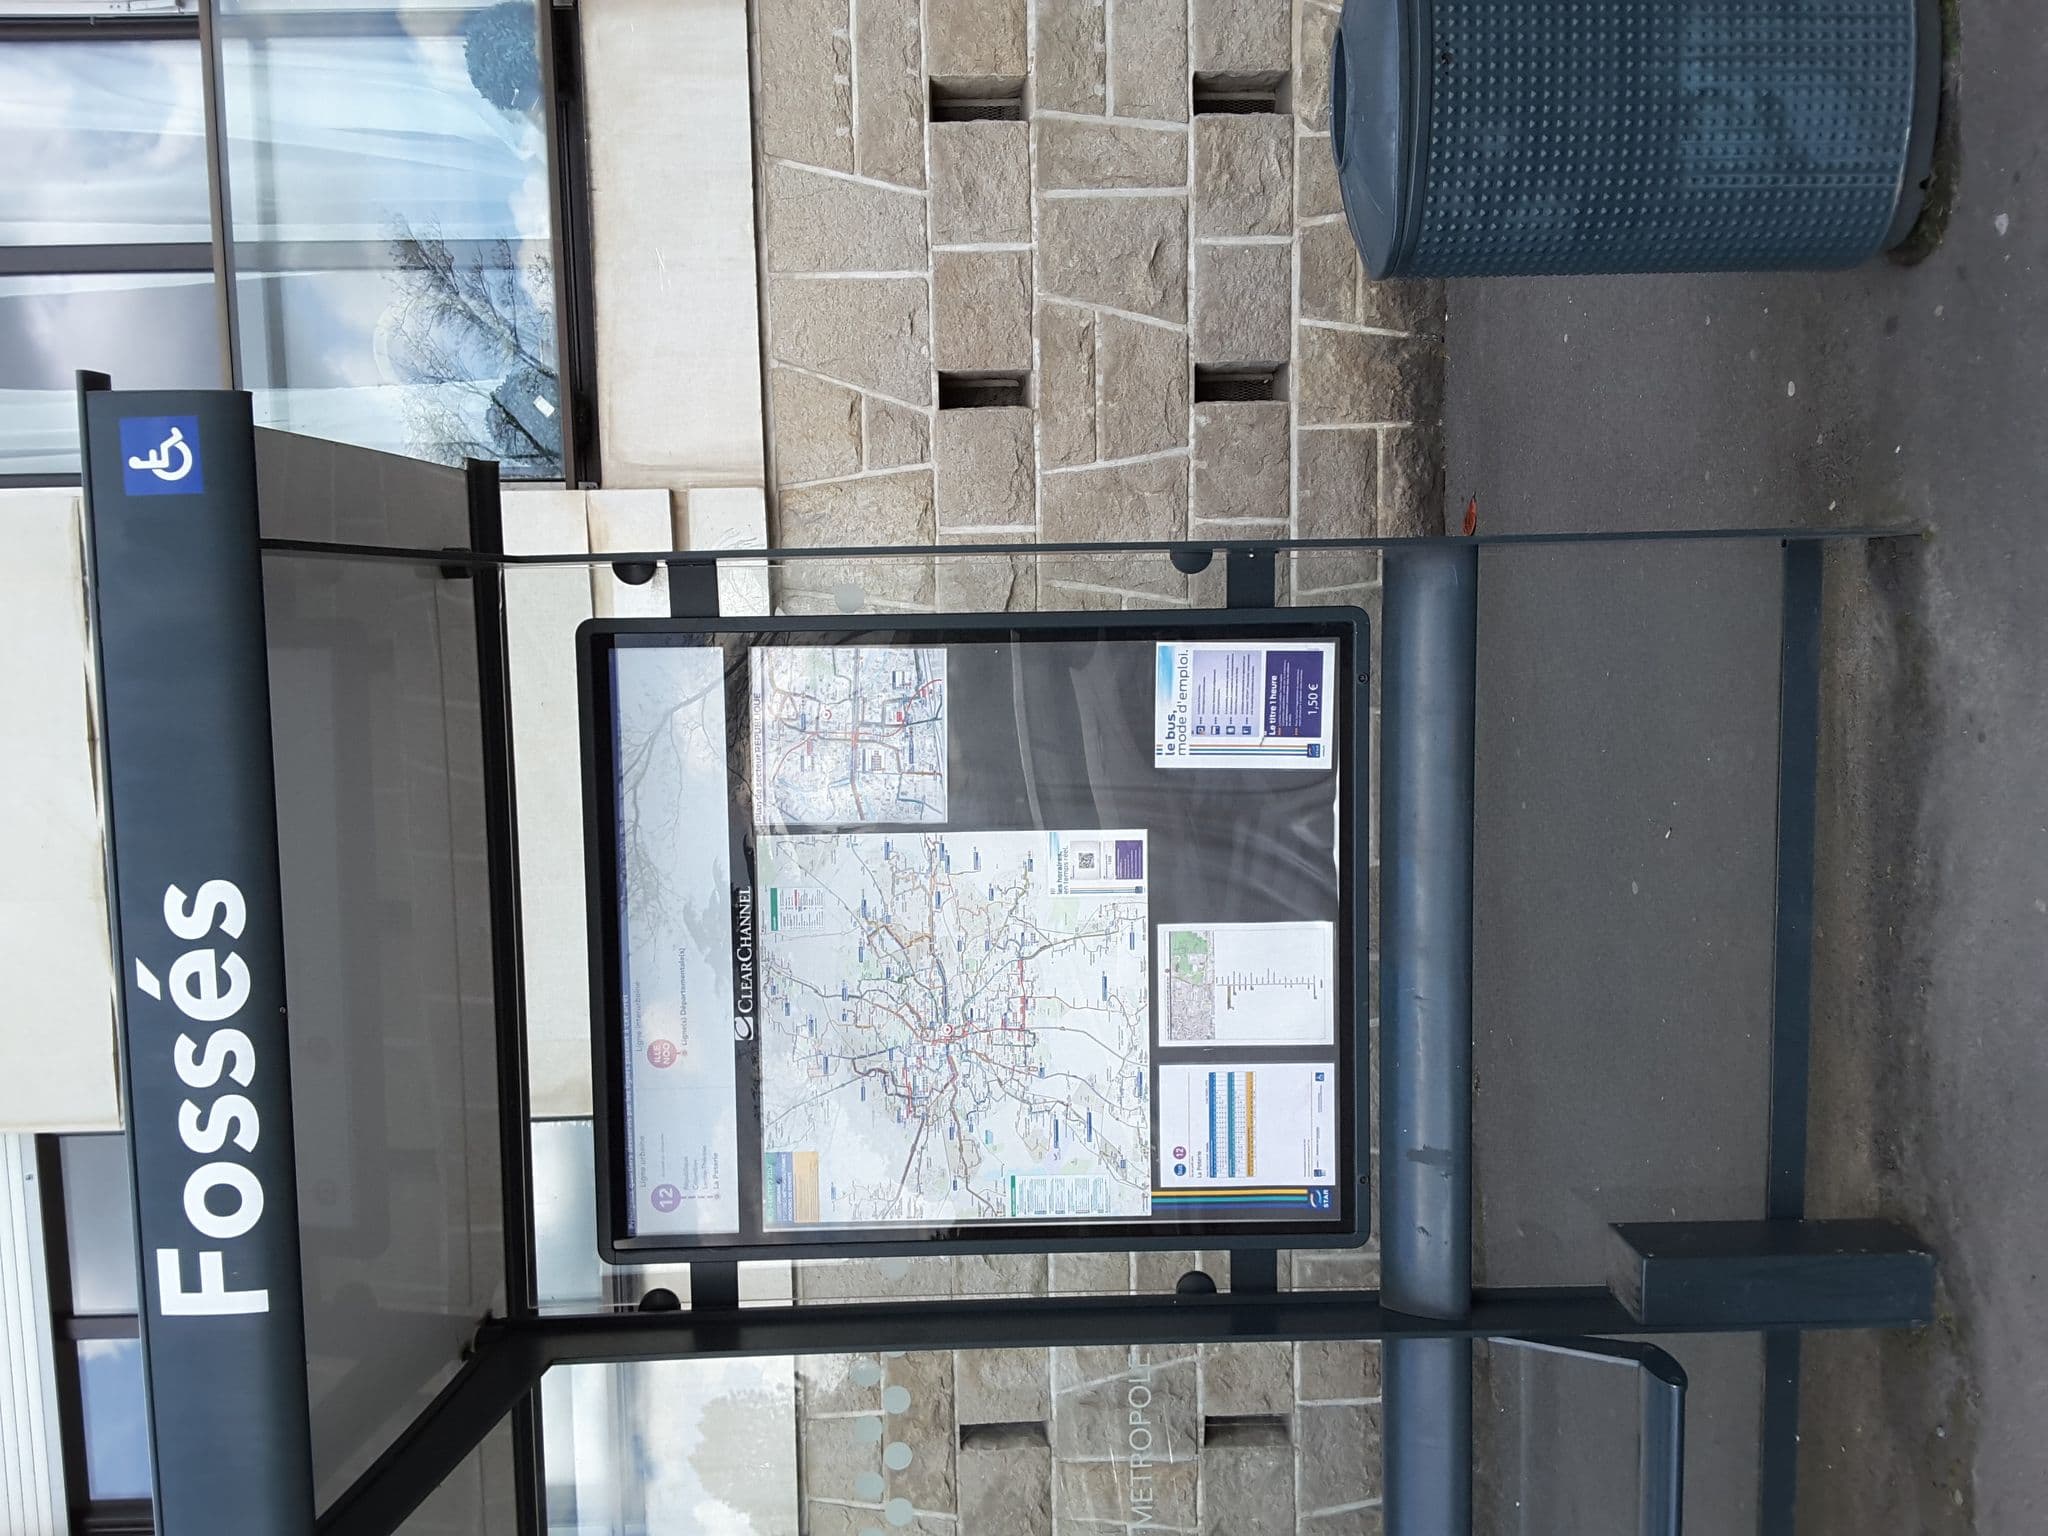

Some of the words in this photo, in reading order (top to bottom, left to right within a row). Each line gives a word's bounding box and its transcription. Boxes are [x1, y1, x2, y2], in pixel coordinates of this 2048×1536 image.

[1176, 649, 1189, 713] d'emploi.
[1269, 675, 1278, 699] heure
[1308, 683, 1318, 691] €
[1269, 705, 1278, 724] titre
[1307, 693, 1319, 715] 1,50
[1165, 710, 1178, 740] bus,
[1269, 725, 1277, 735] Le
[1177, 717, 1188, 756] mode
[1165, 743, 1176, 756] le
[755, 801, 763, 822] Plan
[1056, 851, 1064, 883] horaires,
[1062, 862, 1070, 884] temps
[1063, 885, 1069, 895] en
[678, 948, 688, 1016] Départementale(s)
[634, 982, 642, 1029] interurbaine
[636, 1031, 644, 1052] Ligne
[681, 1017, 689, 1046] Ligne(s)
[653, 1045, 662, 1063] ILLE
[136, 879, 270, 1316] Fossés
[638, 1135, 646, 1164] urbaine
[1175, 1148, 1184, 1157] 12
[639, 1166, 648, 1187] Ligne
[659, 1188, 673, 1208] 12
[1128, 1353, 1153, 1526] METROPOLE
